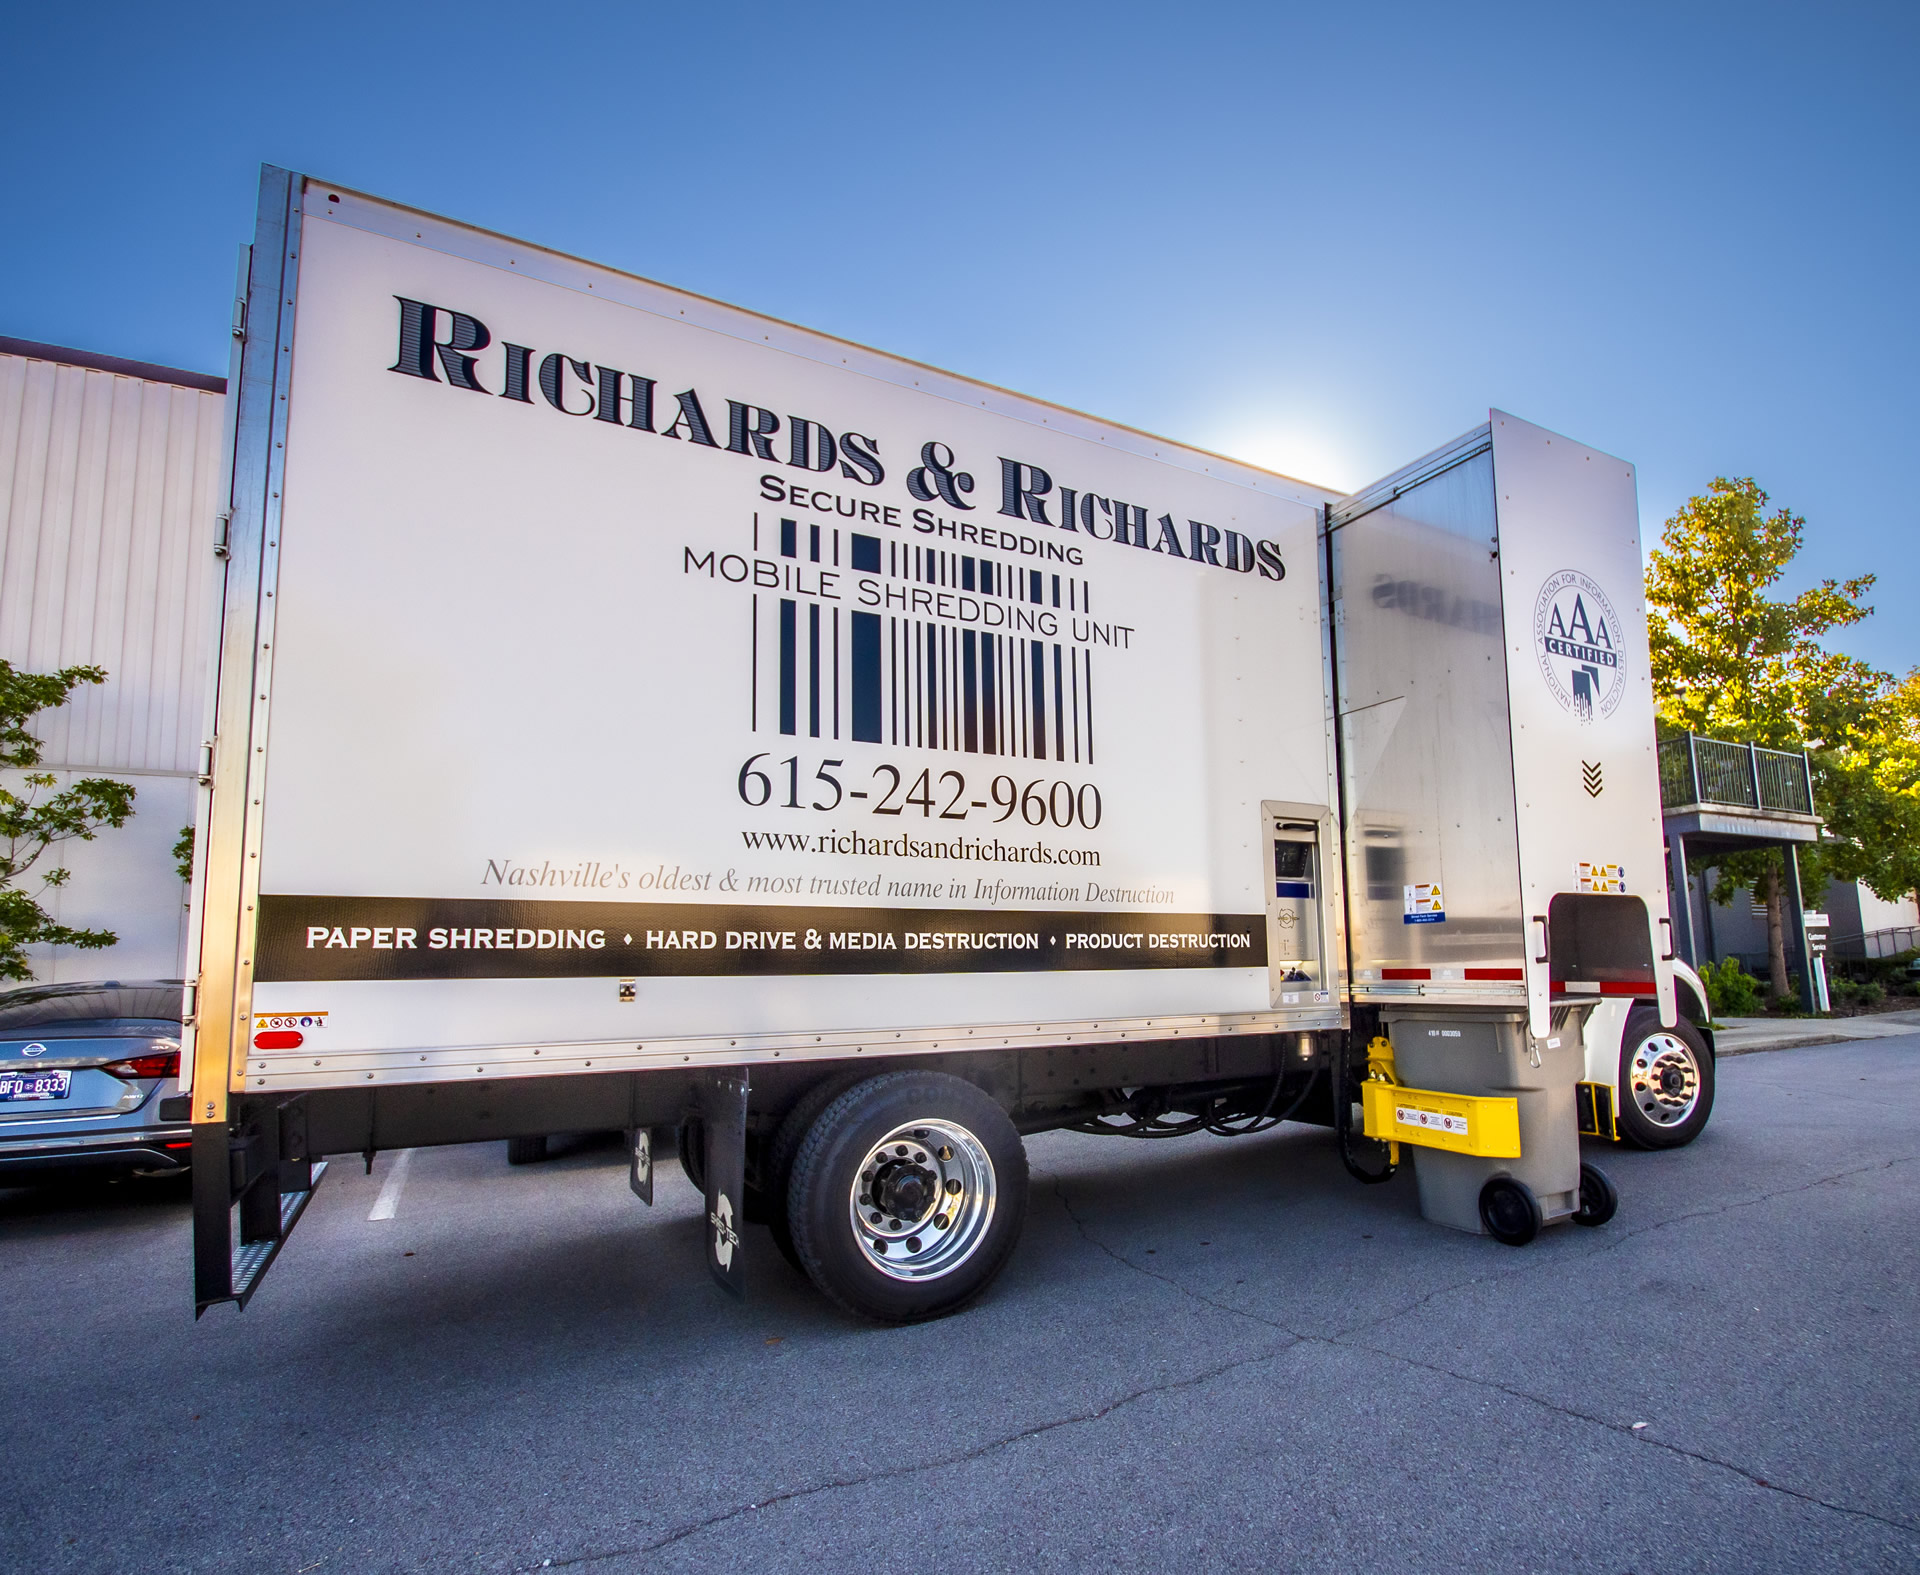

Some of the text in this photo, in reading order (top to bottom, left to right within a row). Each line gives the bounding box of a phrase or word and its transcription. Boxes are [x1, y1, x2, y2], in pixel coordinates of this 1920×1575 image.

[387, 295, 1286, 582] RICHARDS & RICHARDS
[760, 474, 1083, 565] SECURE SHREDDING
[684, 546, 1135, 649] MOBILE SHREDDING UNIT
[1547, 593, 1613, 650] AAA
[1536, 573, 1625, 715] NATIONAL ASSOCIATION FOR INFORMATION DESTRUCTION
[1549, 639, 1614, 666] CERTIFIED
[737, 752, 1102, 830] 615-242-9600
[741, 829, 1101, 866] www.richardsandrichards.com
[480, 858, 1175, 906] Nashville's oldest & most trusted name in Information Destruction
[306, 926, 1251, 950] PAPER SHREDDING HARD DRIVE & MEDIA DESTRUCTION PRODUCT DESTRUCTION
[35, 1078, 66, 1092] 8333
